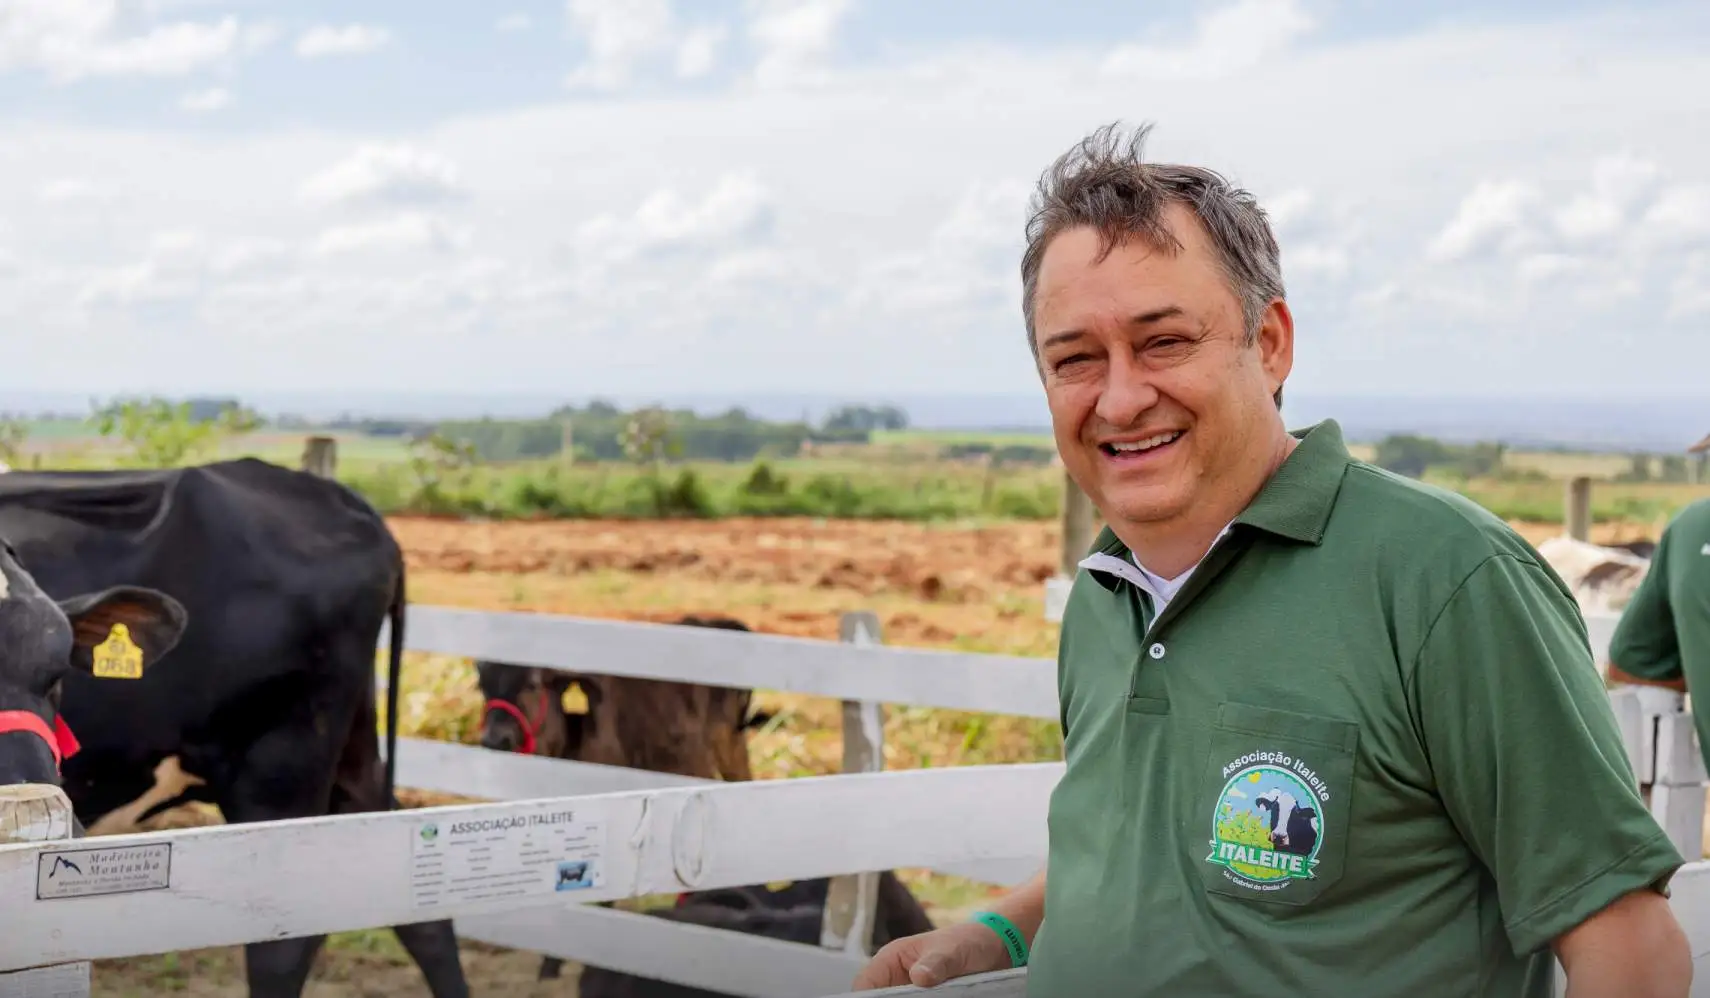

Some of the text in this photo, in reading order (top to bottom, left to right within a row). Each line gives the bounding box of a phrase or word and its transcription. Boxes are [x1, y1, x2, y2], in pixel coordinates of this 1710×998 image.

[1222, 750, 1330, 802] Associação Italeite
[450, 811, 574, 834] ASSOCIAÇÃO ITALEITE
[1219, 842, 1304, 873] ITALEITE
